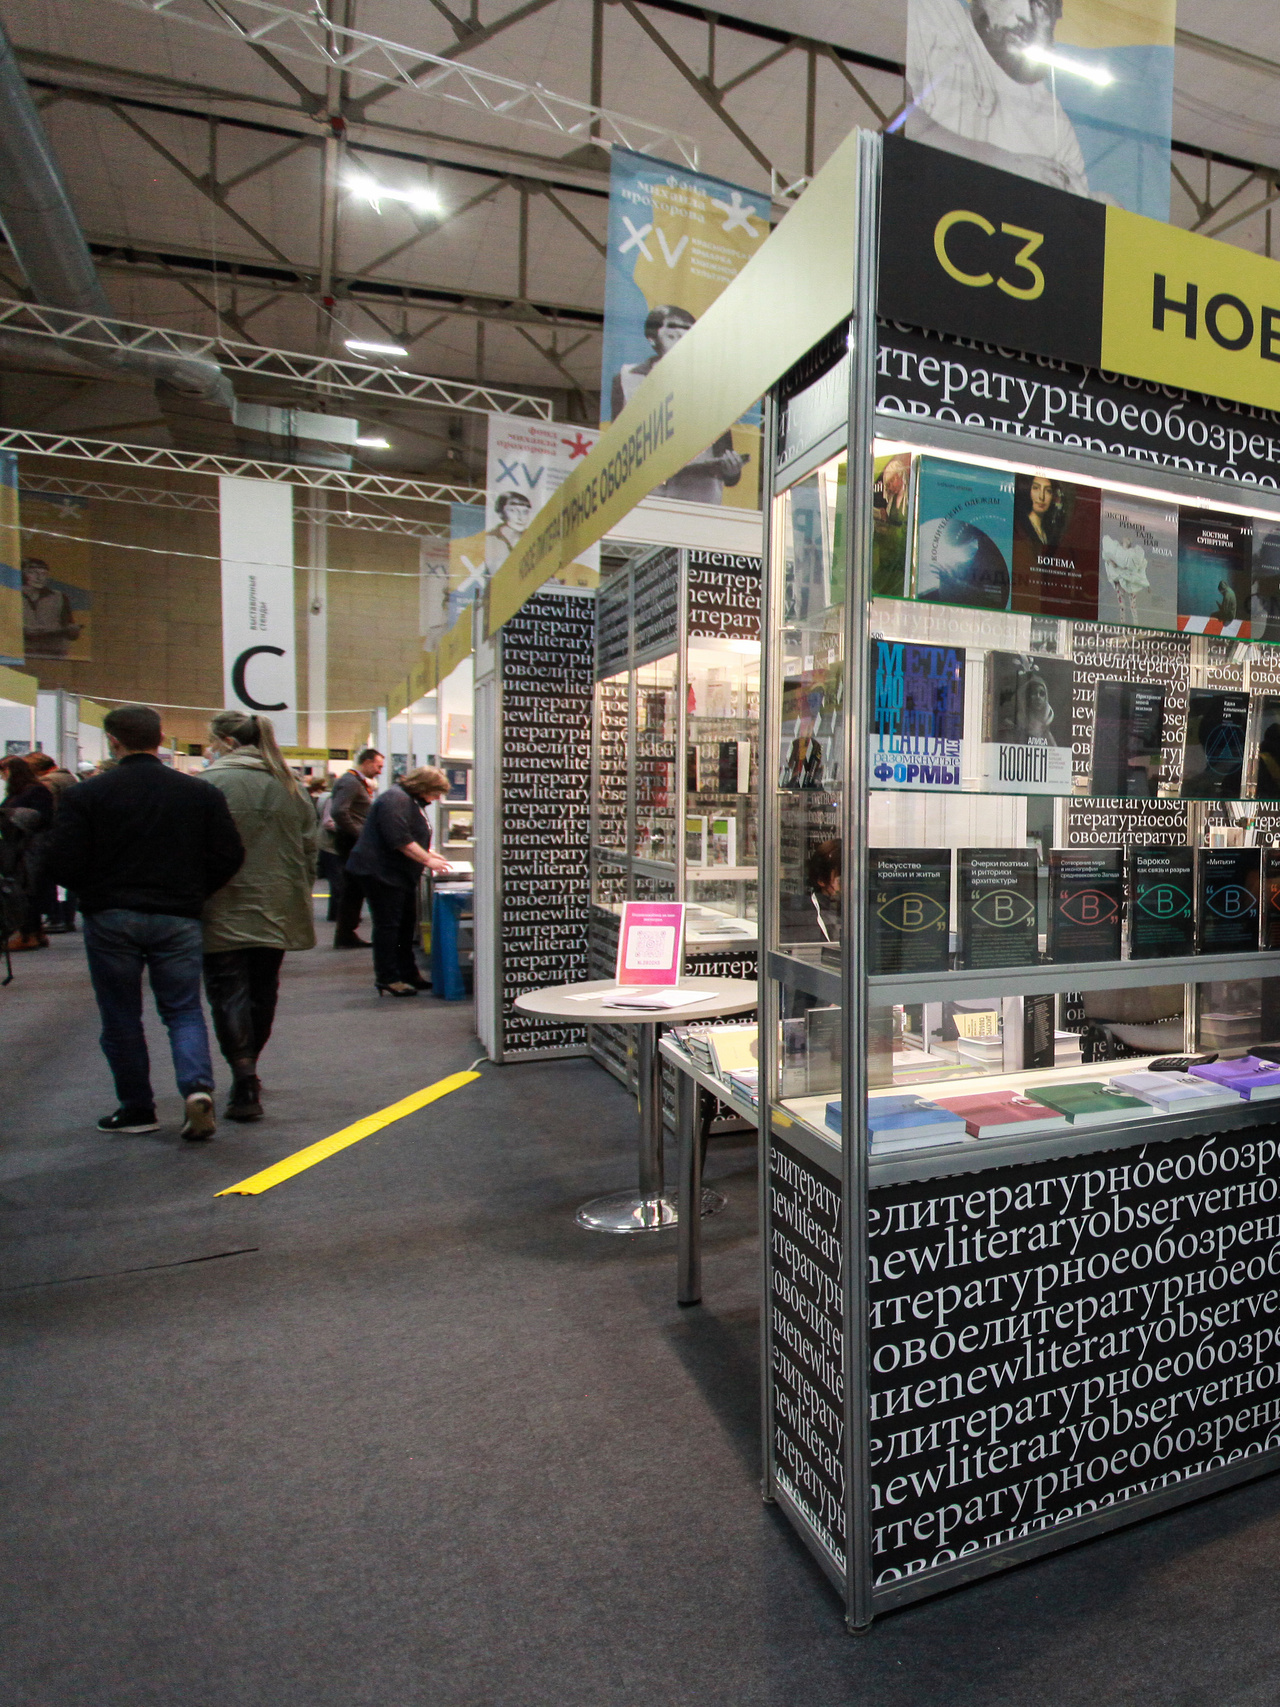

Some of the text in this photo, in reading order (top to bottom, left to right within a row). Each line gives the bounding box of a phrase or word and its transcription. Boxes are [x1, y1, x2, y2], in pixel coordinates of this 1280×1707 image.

[618, 215, 689, 269] XV
[600, 391, 674, 505] ОБОЗРЕНИЕ
[495, 459, 544, 489] XV
[965, 497, 1000, 508] ОДЕЖДЫ
[1105, 512, 1129, 521] ЭКСПЕ
[1119, 521, 1145, 531] РИМЕН
[1136, 531, 1154, 540] ТАЛЬ
[1202, 530, 1229, 541] КОСТЮМ
[1143, 539, 1159, 547] НАЯ
[1197, 536, 1234, 548] СУПЕРГЕРОЯ
[1152, 547, 1173, 557] МОДА
[1037, 555, 1075, 569] БОГЕМА
[1028, 737, 1048, 746] АЛИСА
[874, 752, 961, 766] разомкнутые
[999, 745, 1048, 783] КООНЕН
[874, 763, 960, 785] ФОРМЫ
[878, 861, 921, 870] Искусство
[971, 859, 1029, 868] Очерки поэтики
[1137, 857, 1170, 865] Барокко
[878, 870, 908, 878] кройки
[978, 868, 1012, 878] риторики
[1101, 871, 1120, 879] Запада
[1169, 867, 1191, 875] разрыв
[971, 876, 1018, 885] архитектуры
